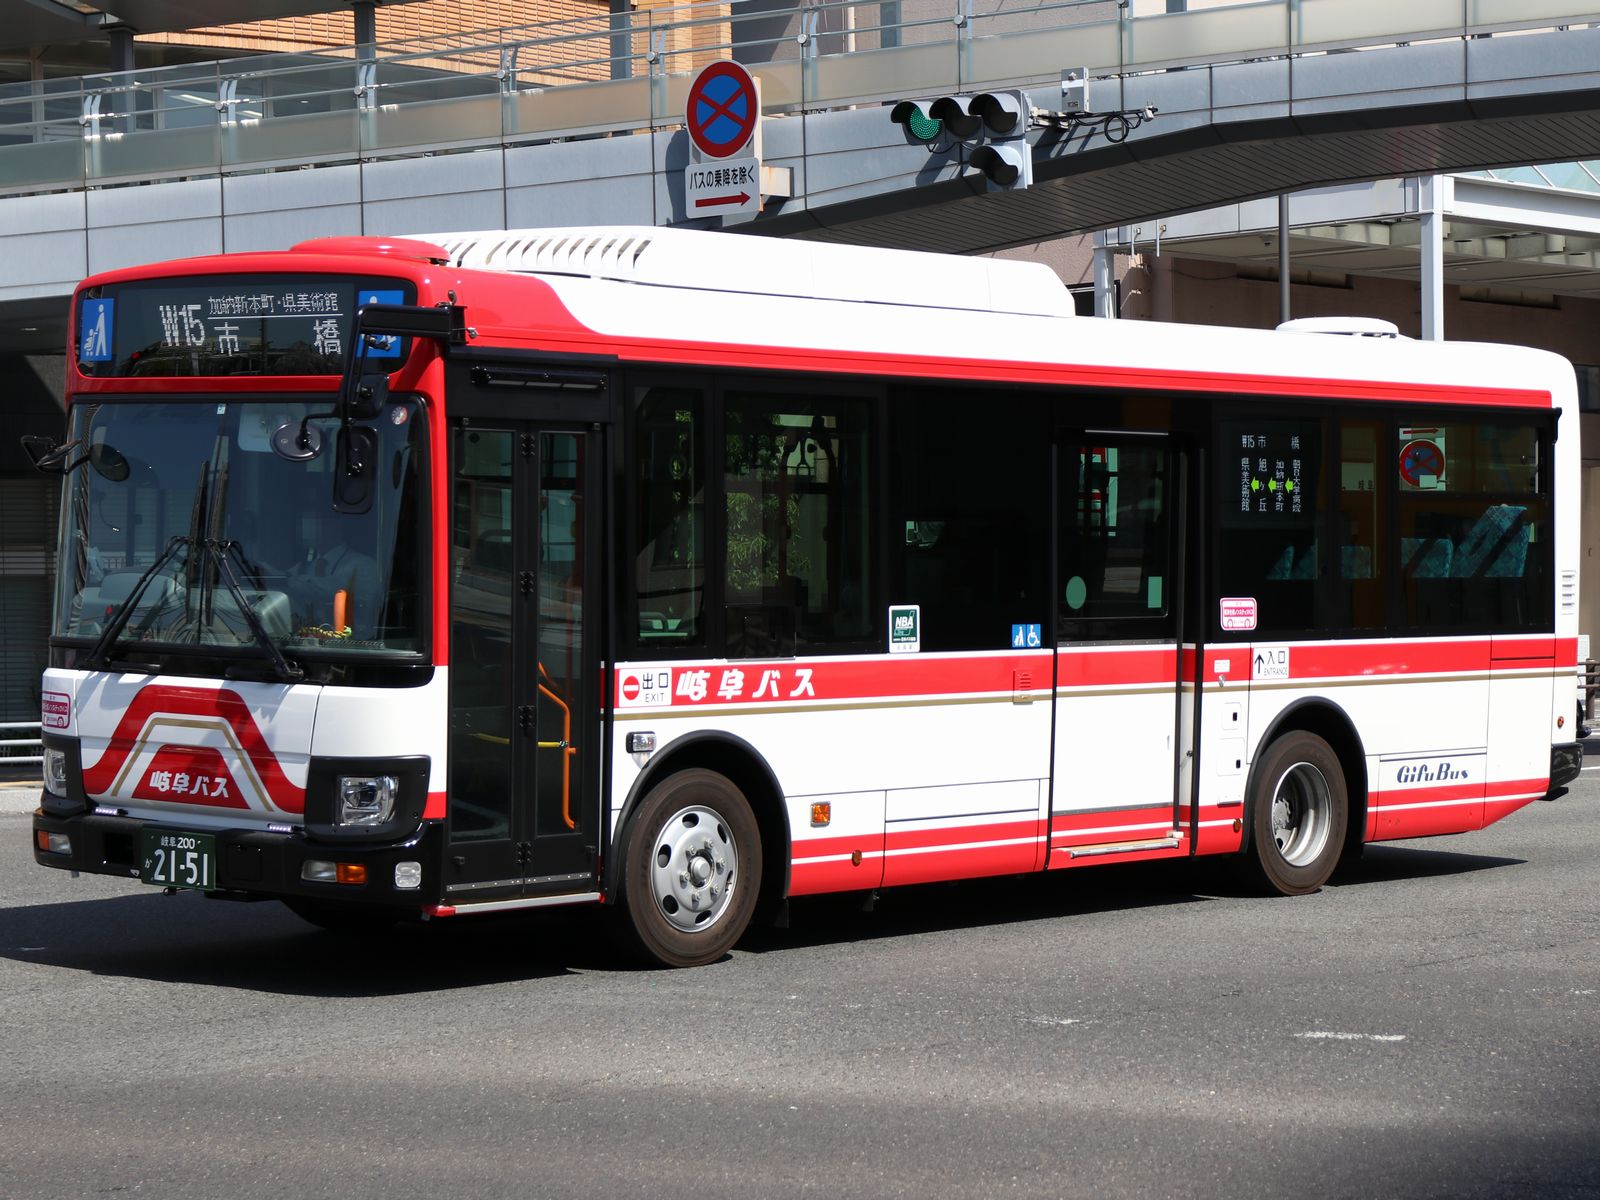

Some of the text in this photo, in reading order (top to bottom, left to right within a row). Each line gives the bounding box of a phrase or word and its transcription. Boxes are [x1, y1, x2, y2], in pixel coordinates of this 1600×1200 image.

[689, 164, 755, 190] バスの乗降を除く
[158, 303, 206, 348] W15
[895, 616, 914, 628] NBA
[1266, 650, 1286, 665] 入口
[642, 672, 669, 690] 出口
[1263, 667, 1288, 676] ENTRANCE
[675, 668, 816, 701] 岐阜バス
[645, 693, 665, 702] EXIT
[149, 770, 229, 798] 岐阜バス
[153, 848, 209, 886] 21-51
